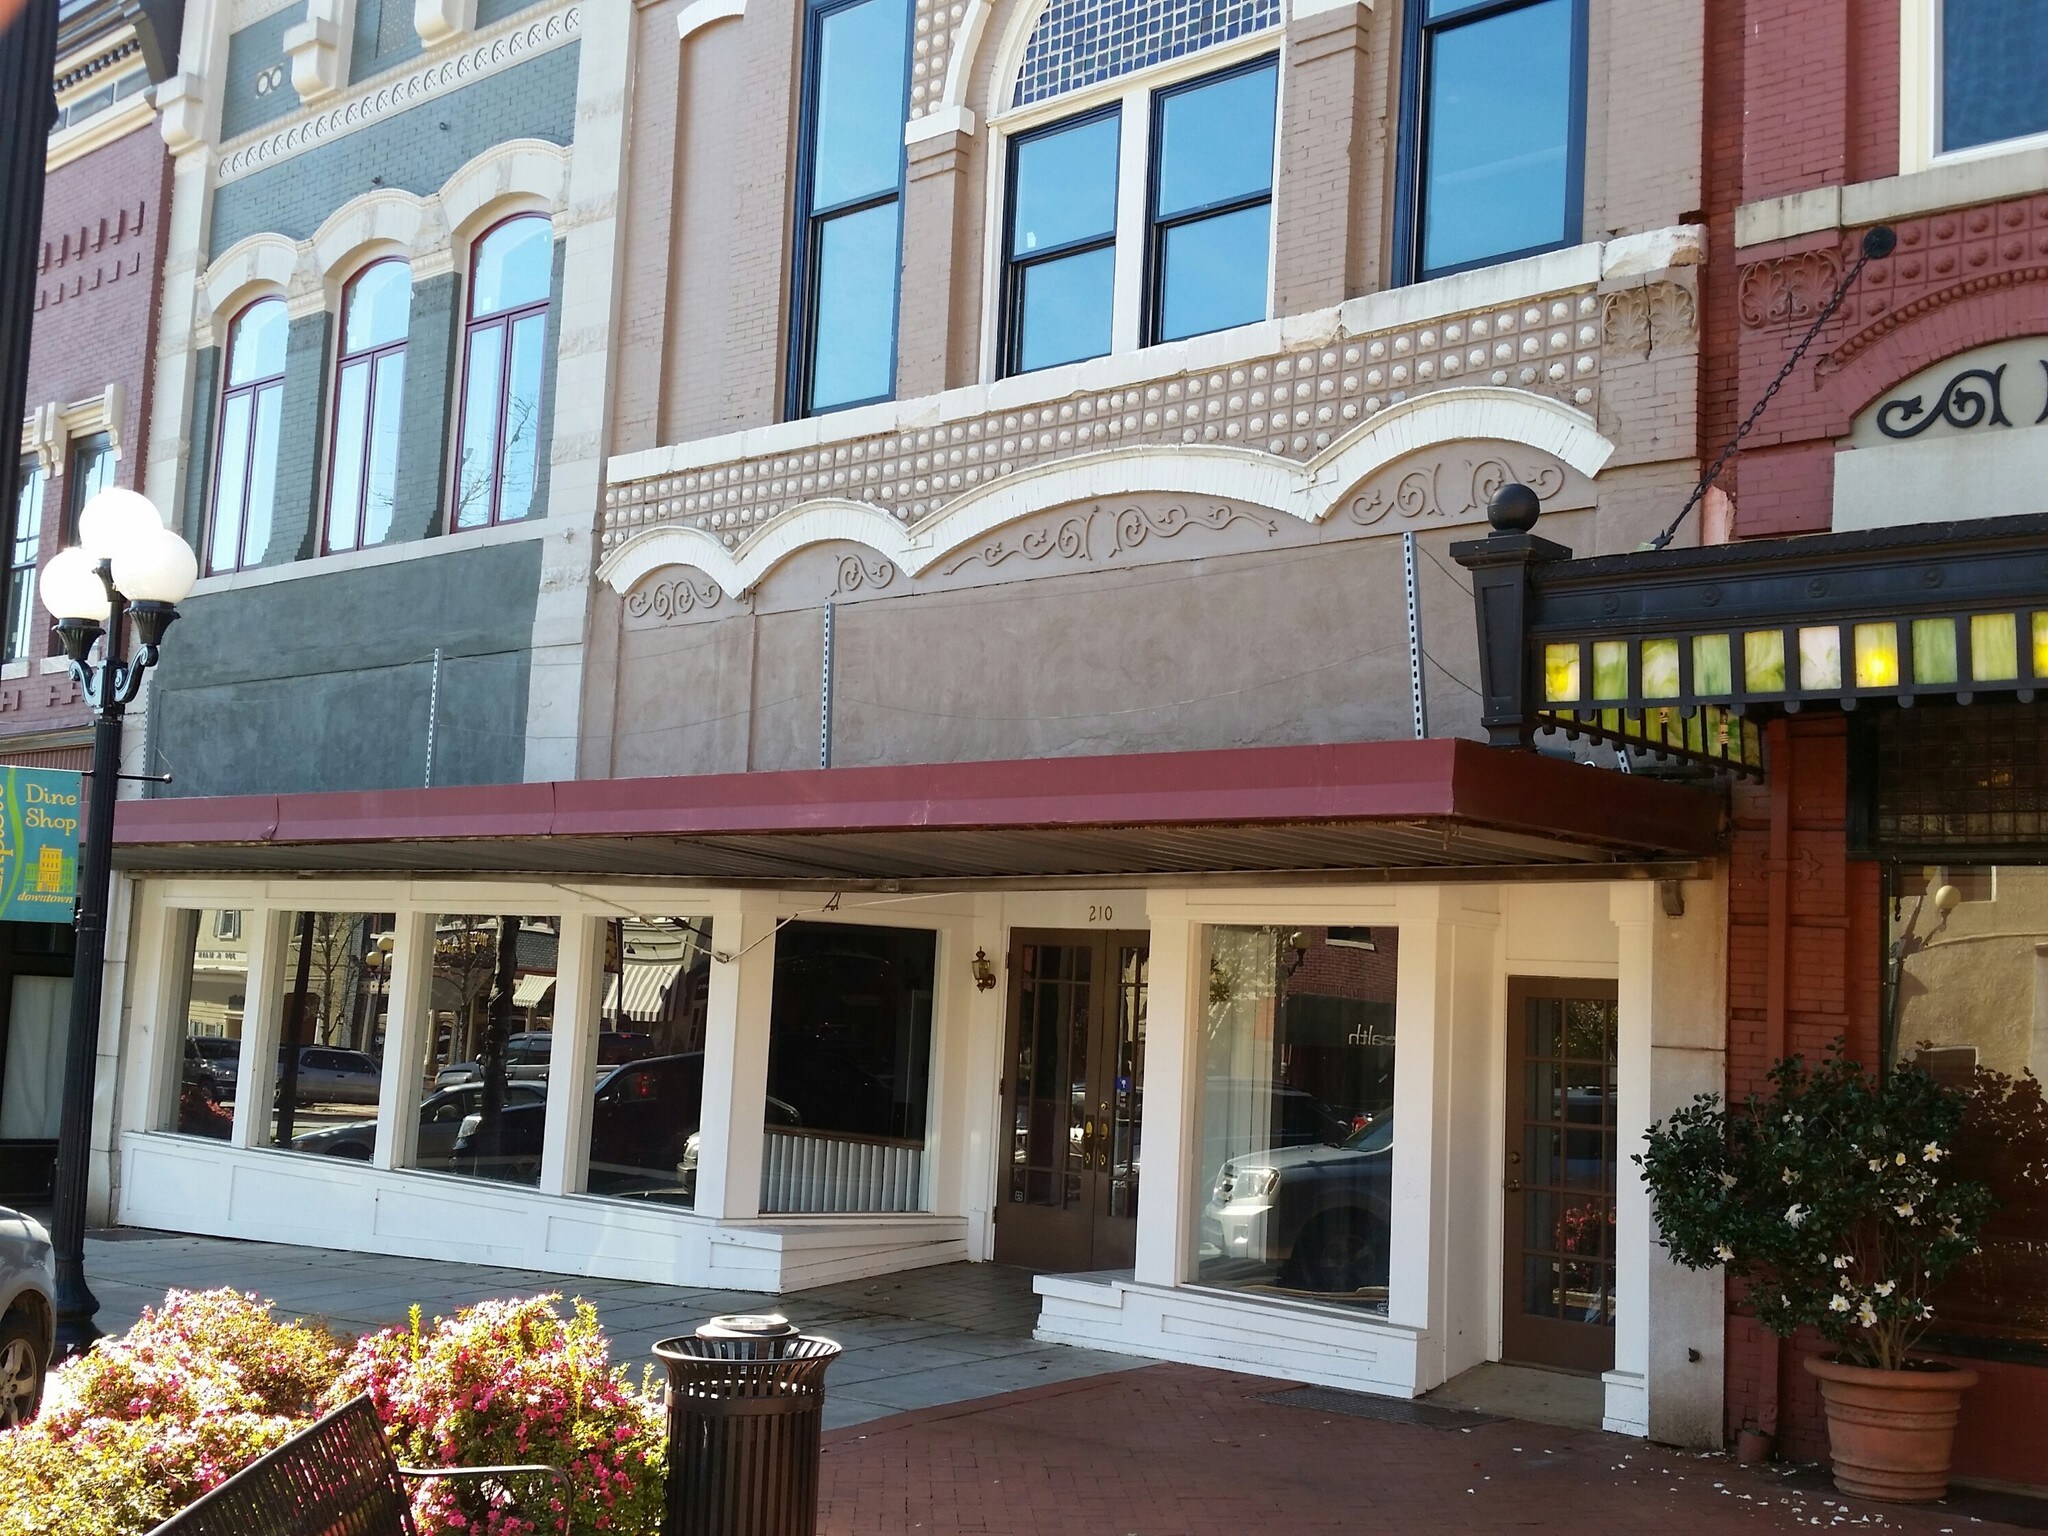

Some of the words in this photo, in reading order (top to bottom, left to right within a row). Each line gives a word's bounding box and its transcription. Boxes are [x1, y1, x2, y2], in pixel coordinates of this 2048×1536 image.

[25, 783, 77, 806] Dine
[25, 808, 77, 836] Shop
[17, 890, 73, 904] downtown
[1089, 905, 1113, 922] 210
